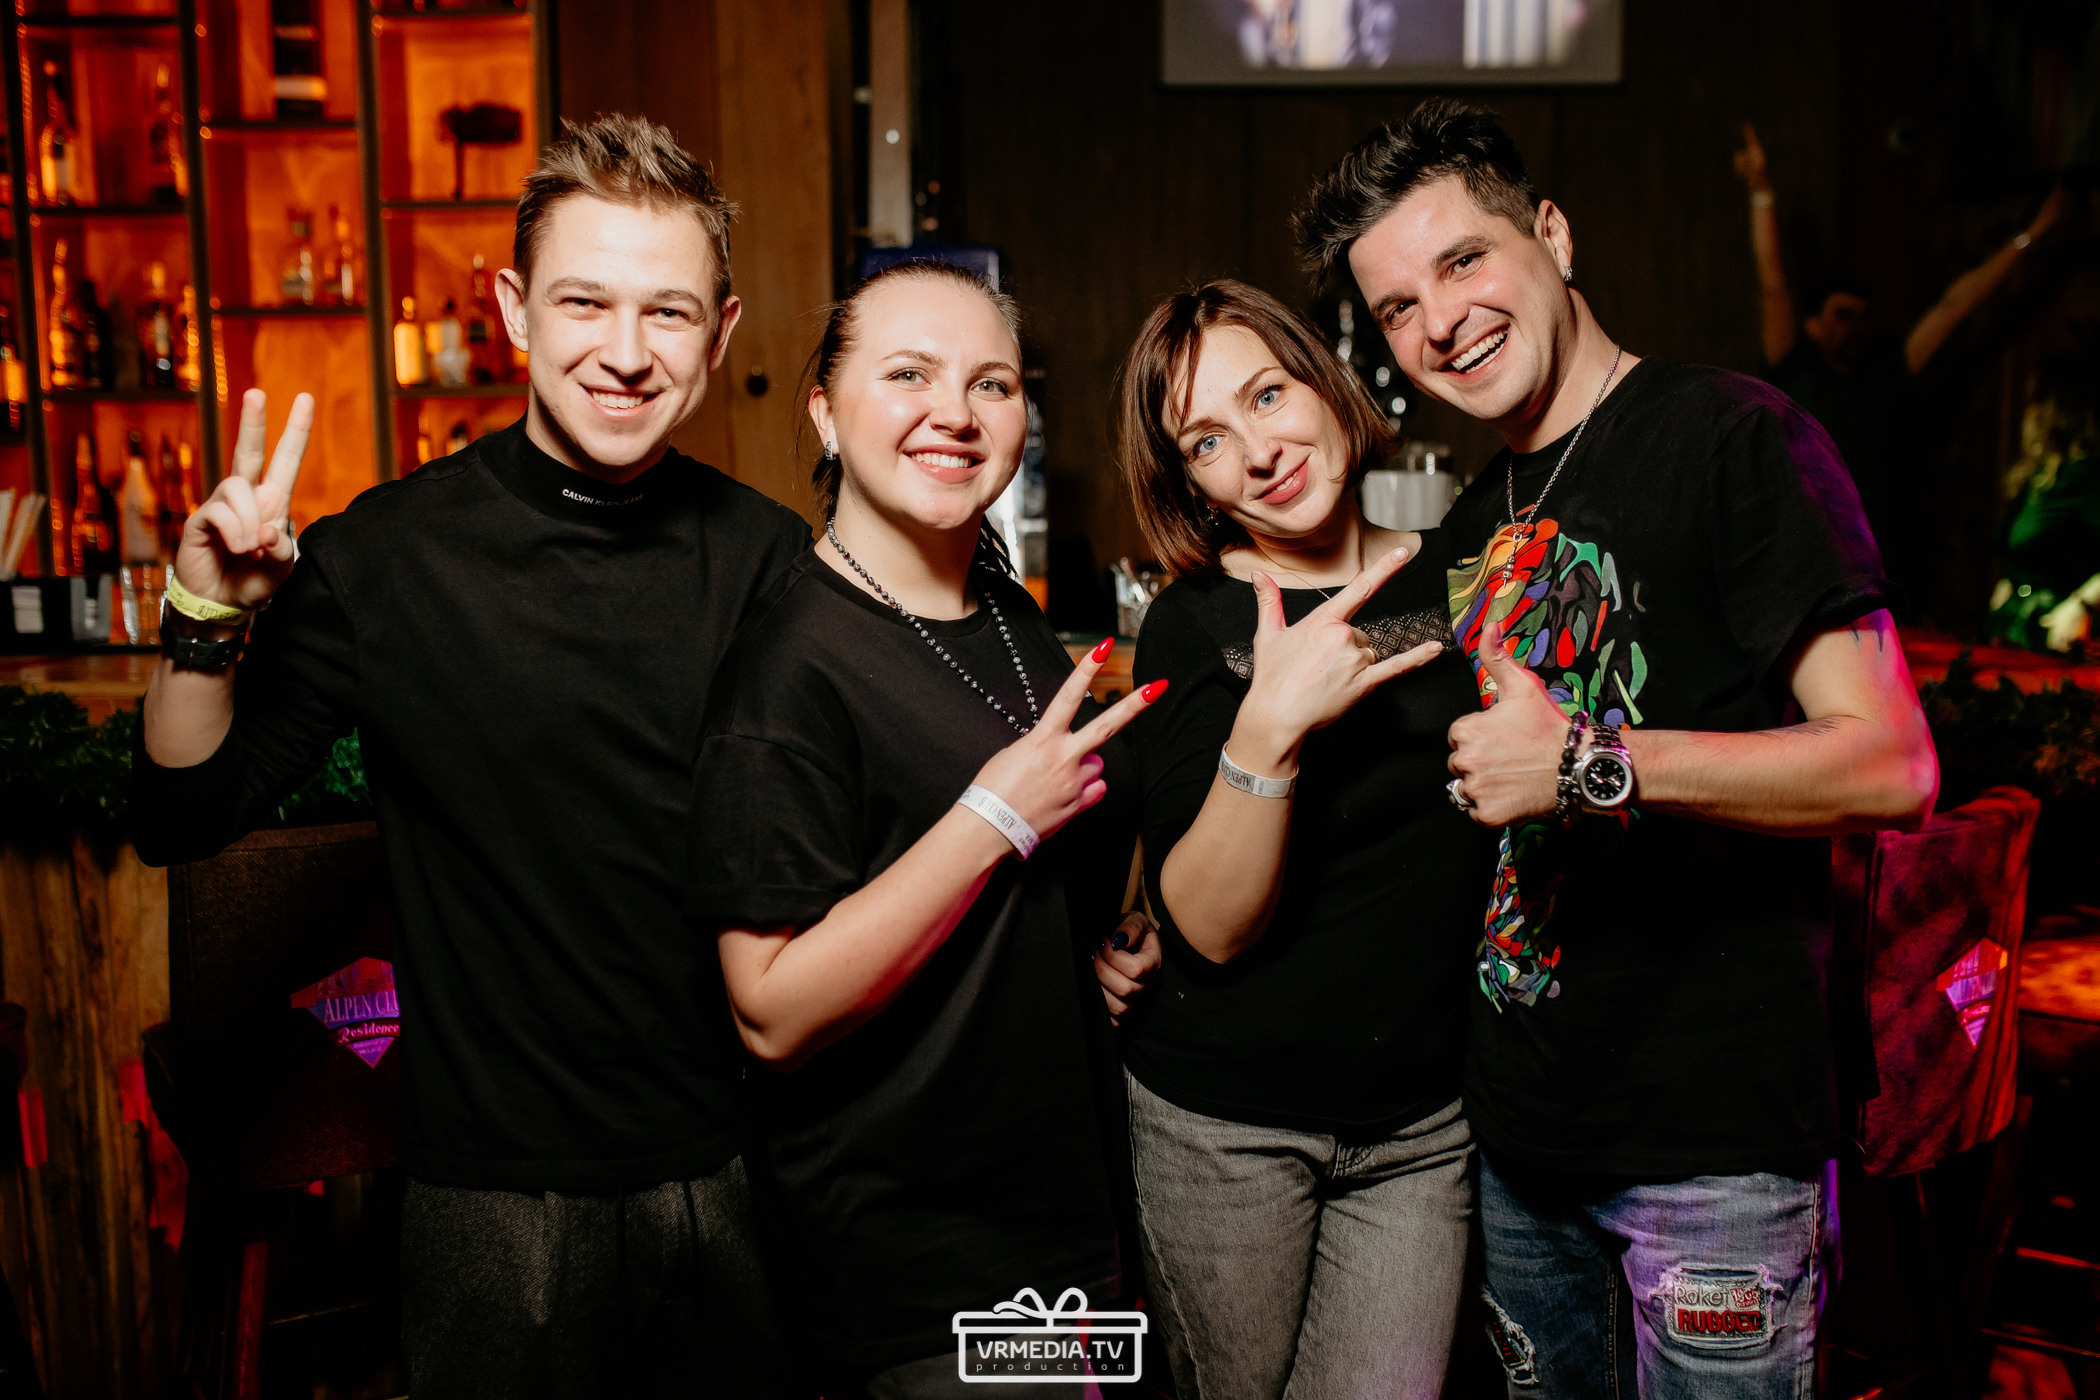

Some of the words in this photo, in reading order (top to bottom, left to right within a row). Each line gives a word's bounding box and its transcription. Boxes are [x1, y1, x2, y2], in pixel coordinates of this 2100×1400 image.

[562, 488, 594, 504] CALVIN
[996, 808, 1017, 830] ALPEN
[324, 993, 372, 1023] ALPEN
[338, 1022, 400, 1044] Residence
